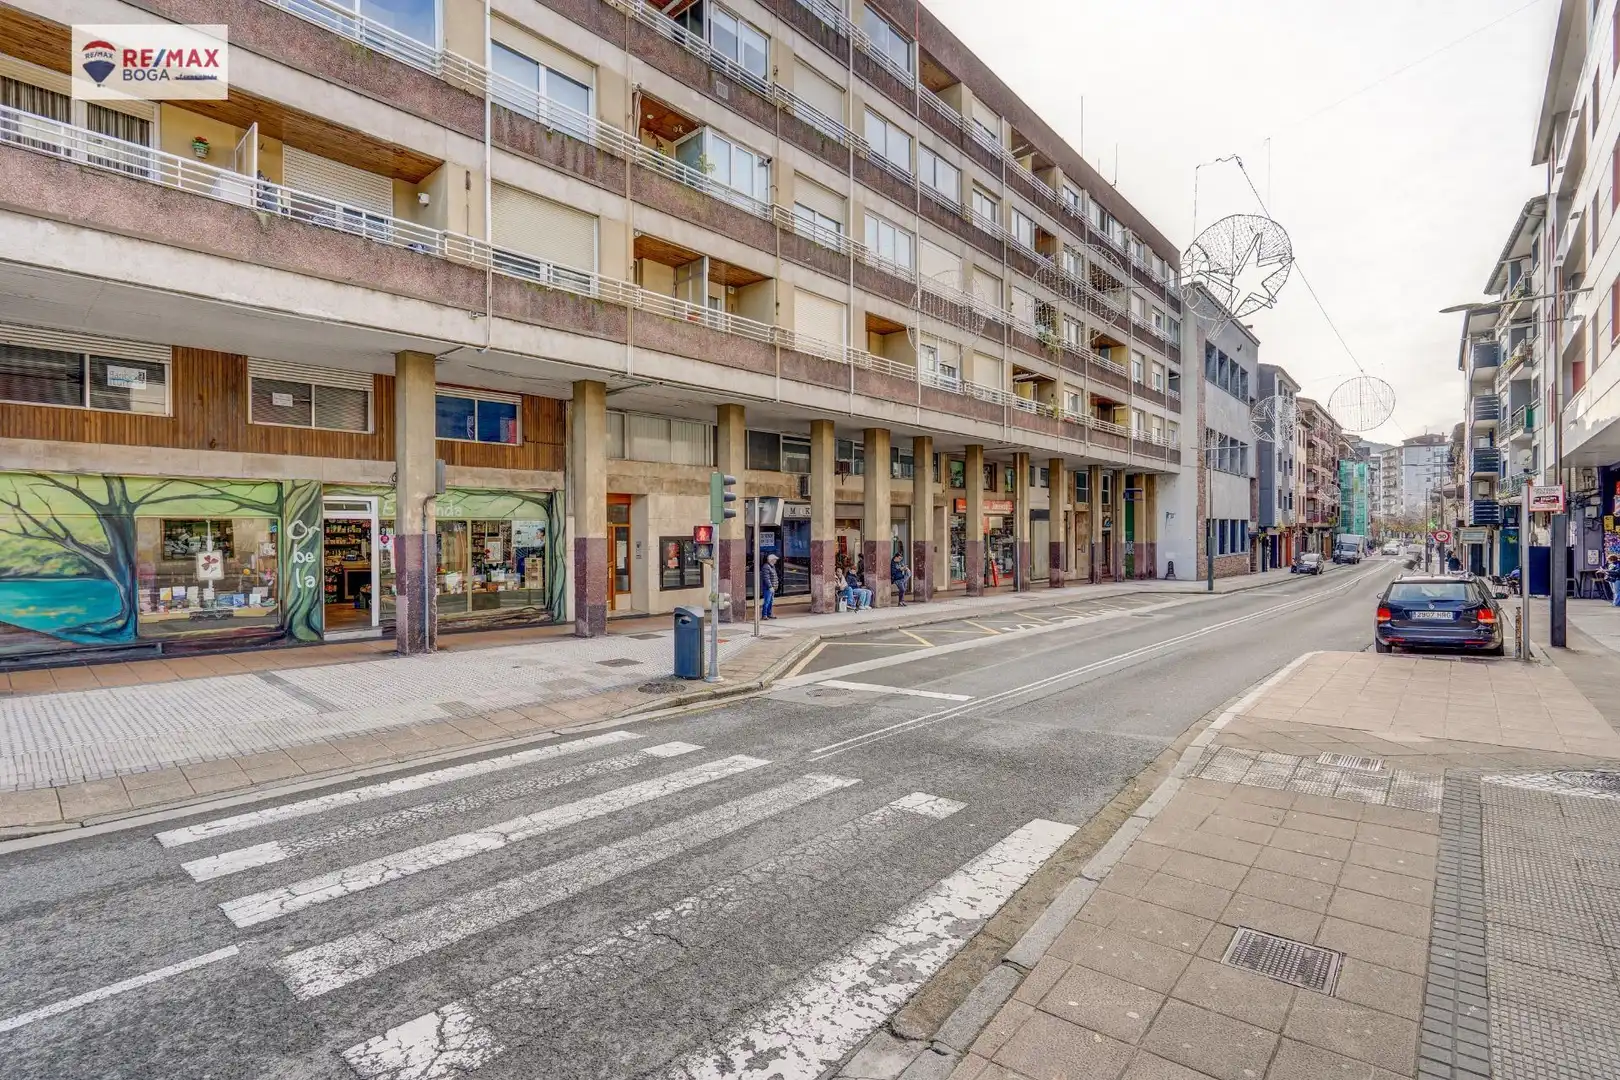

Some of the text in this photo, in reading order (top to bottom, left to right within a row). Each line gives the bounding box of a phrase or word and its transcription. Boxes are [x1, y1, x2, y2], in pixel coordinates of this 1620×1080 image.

[287, 519, 320, 542] Or
[293, 543, 316, 564] be
[296, 567, 316, 589] la
